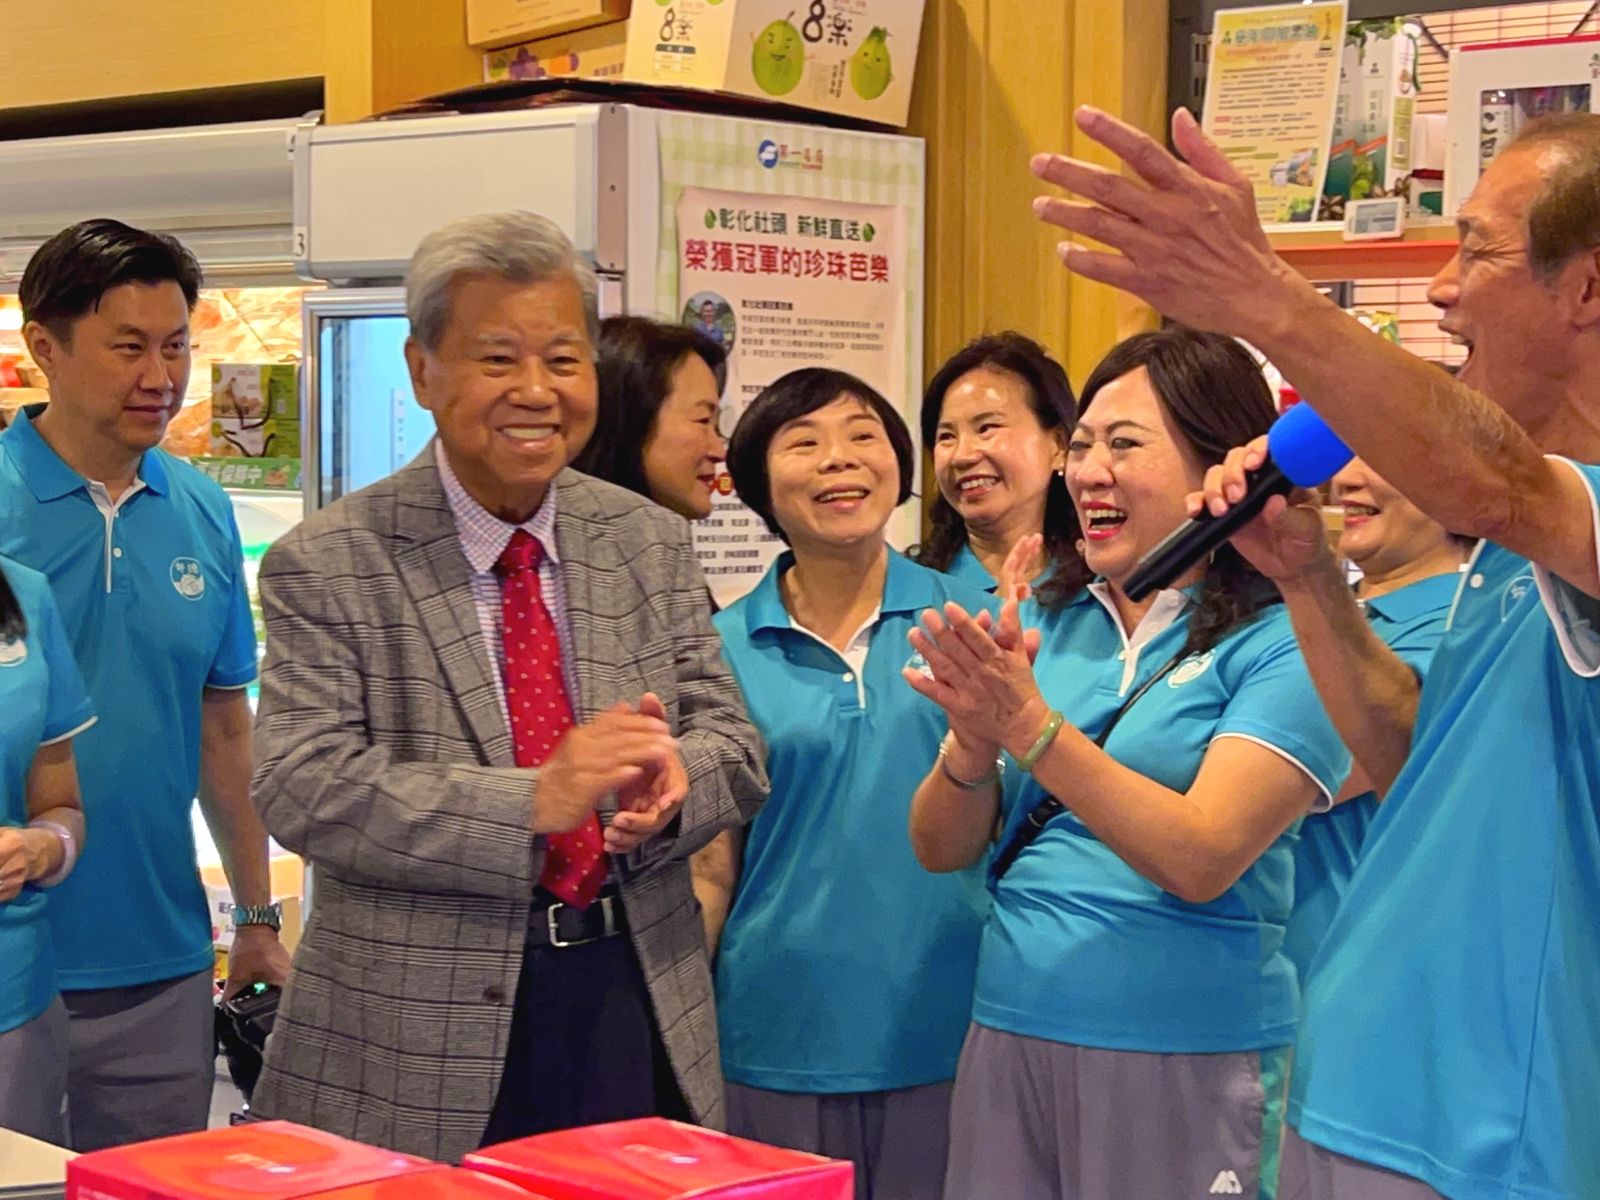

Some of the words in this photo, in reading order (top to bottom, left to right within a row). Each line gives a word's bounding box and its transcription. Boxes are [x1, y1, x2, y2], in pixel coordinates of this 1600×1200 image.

[719, 208, 788, 236] 彰化社頭
[797, 214, 861, 242] 新鮮直送
[684, 238, 890, 284] 榮獲冠軍的珍珠芭樂
